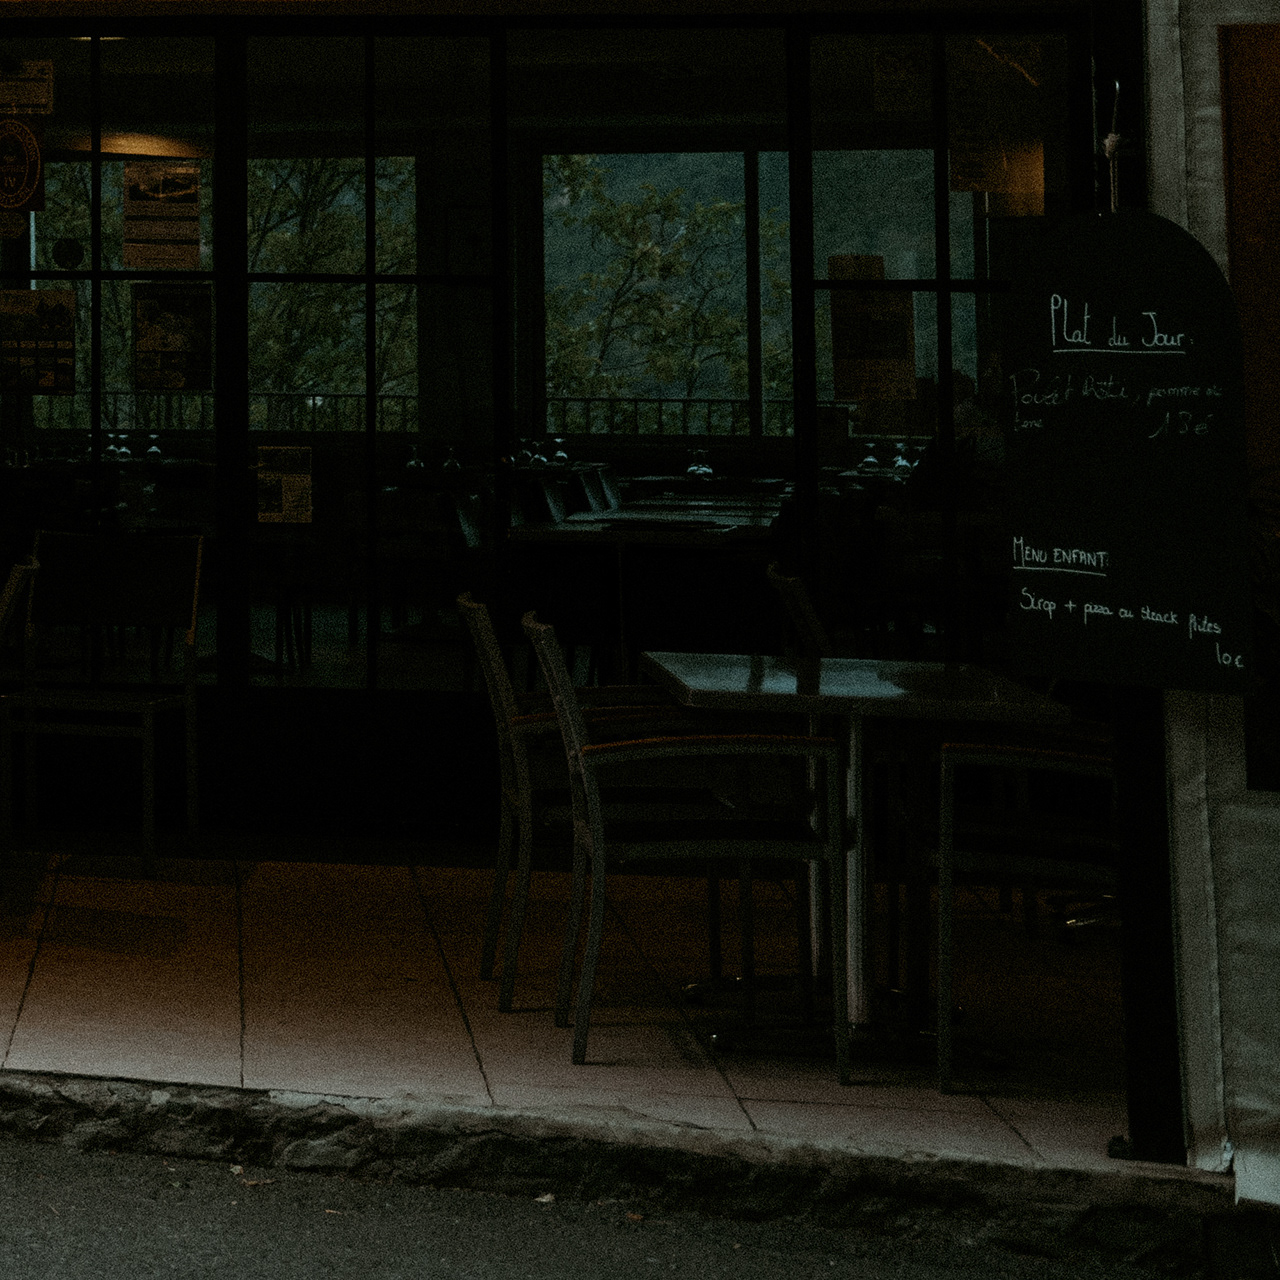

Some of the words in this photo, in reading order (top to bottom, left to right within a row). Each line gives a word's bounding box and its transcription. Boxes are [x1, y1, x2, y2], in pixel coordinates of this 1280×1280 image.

[1051, 293, 1092, 347] Plat
[1108, 316, 1131, 348] du
[1020, 586, 1057, 620] Sirop
[1084, 601, 1114, 625] pizza
[1119, 608, 1134, 619] ou
